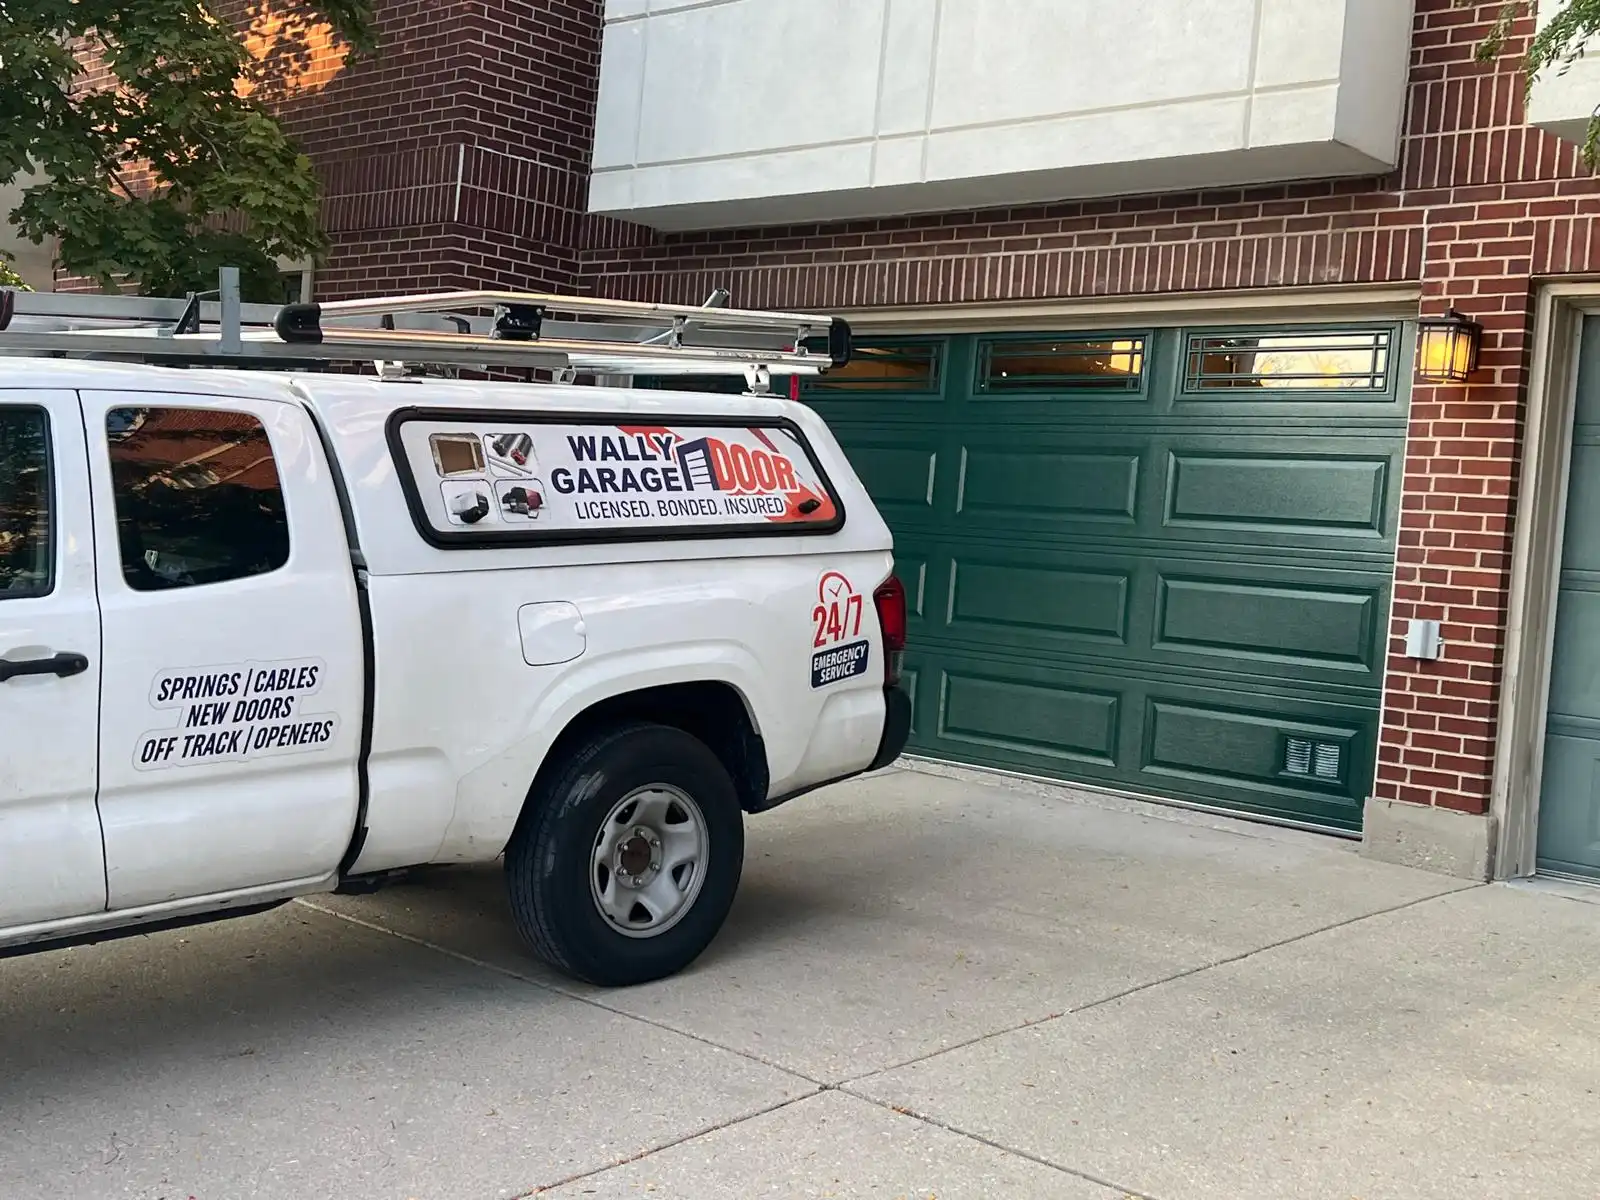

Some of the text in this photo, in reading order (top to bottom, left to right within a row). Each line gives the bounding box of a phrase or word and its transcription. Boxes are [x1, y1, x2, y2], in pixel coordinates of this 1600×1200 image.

[567, 435, 676, 462] WALLY
[551, 438, 798, 494] GARAGE DOOR
[575, 497, 784, 520] LICENSED. BONDED. INSURED
[813, 595, 862, 648] 24/7
[813, 645, 866, 671] EMERGENCY
[820, 661, 856, 682] SERVICE
[157, 673, 241, 701] SPRINGS
[254, 666, 318, 693] CABLES
[186, 696, 294, 728] NEW DOORS
[141, 737, 178, 763] OFF
[182, 730, 243, 758] TRACK
[253, 720, 333, 749] OPENERS
